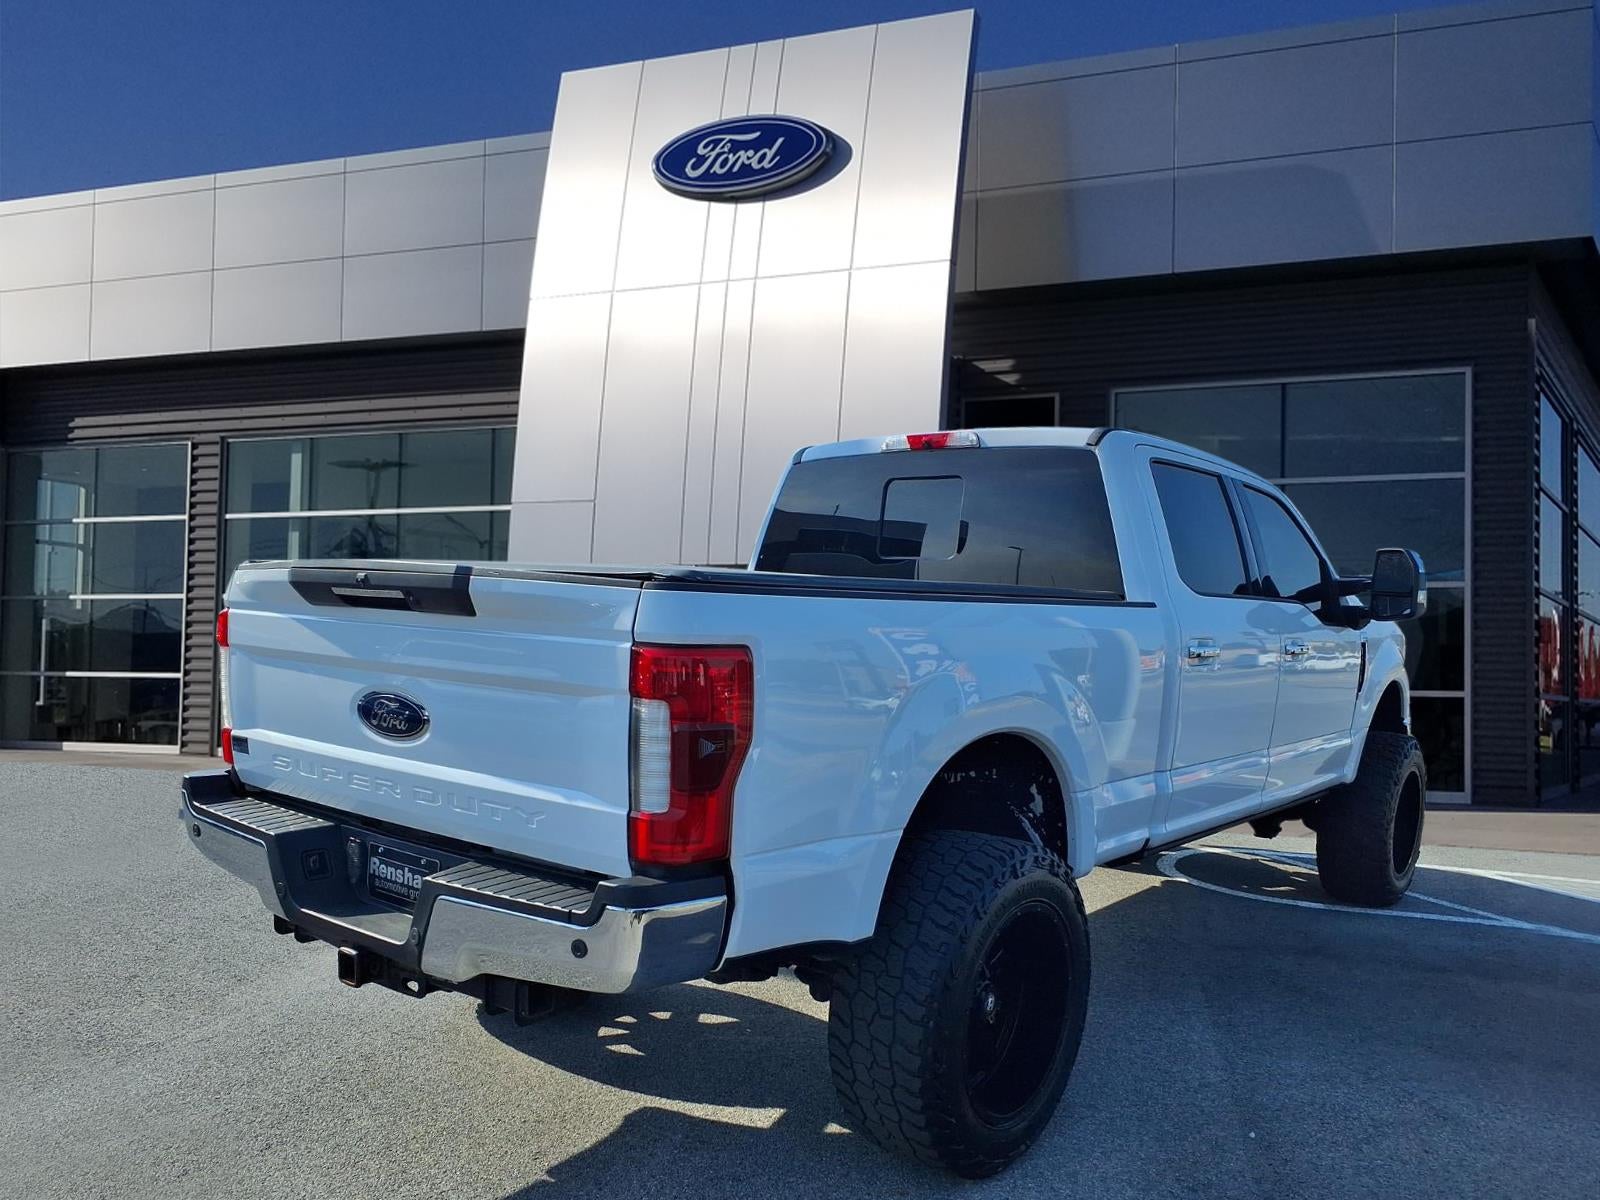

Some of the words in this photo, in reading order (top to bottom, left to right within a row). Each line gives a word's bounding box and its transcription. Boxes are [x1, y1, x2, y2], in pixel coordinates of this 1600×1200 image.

[685, 131, 780, 178] Ford
[370, 699, 409, 730] Ford
[271, 754, 401, 798] SUPER
[412, 786, 546, 828] DUTY
[370, 856, 423, 889] Rensha
